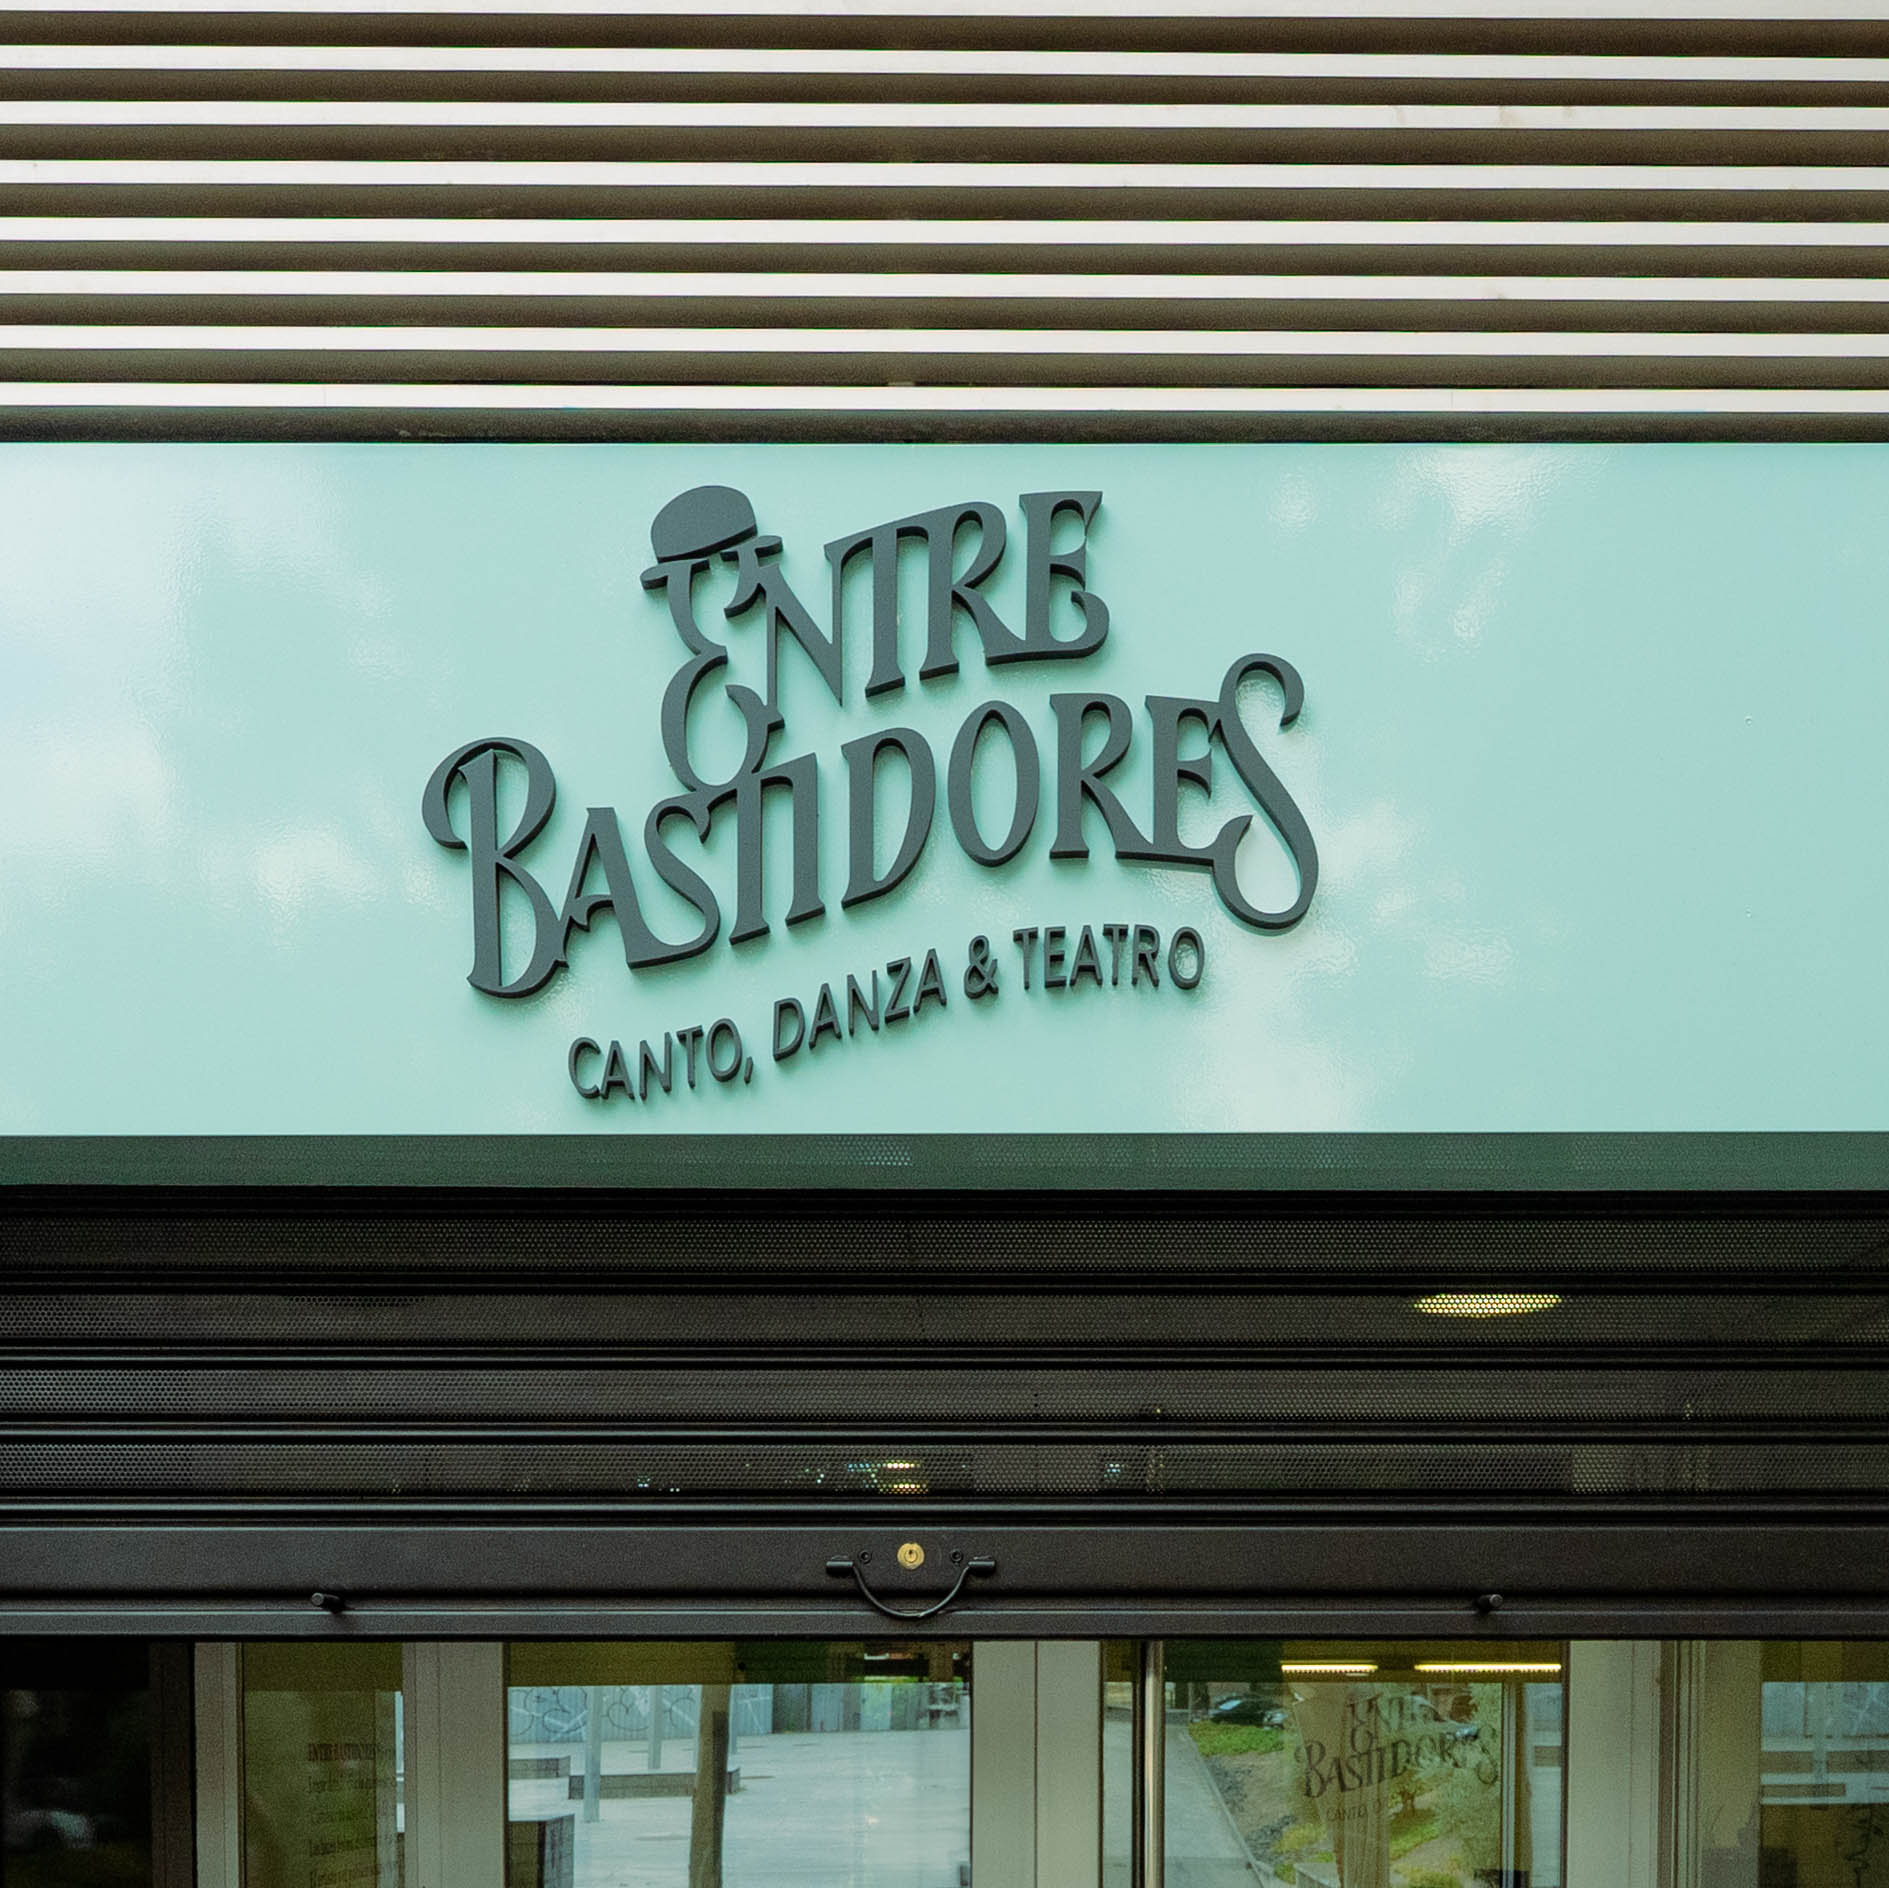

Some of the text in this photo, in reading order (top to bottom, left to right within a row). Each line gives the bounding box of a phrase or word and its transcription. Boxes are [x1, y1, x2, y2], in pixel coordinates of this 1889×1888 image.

[641, 487, 1110, 796] ENTRE
[421, 652, 1320, 999] BASTIDORES
[567, 922, 1206, 1101] CANTO, DANZA & TEATRO
